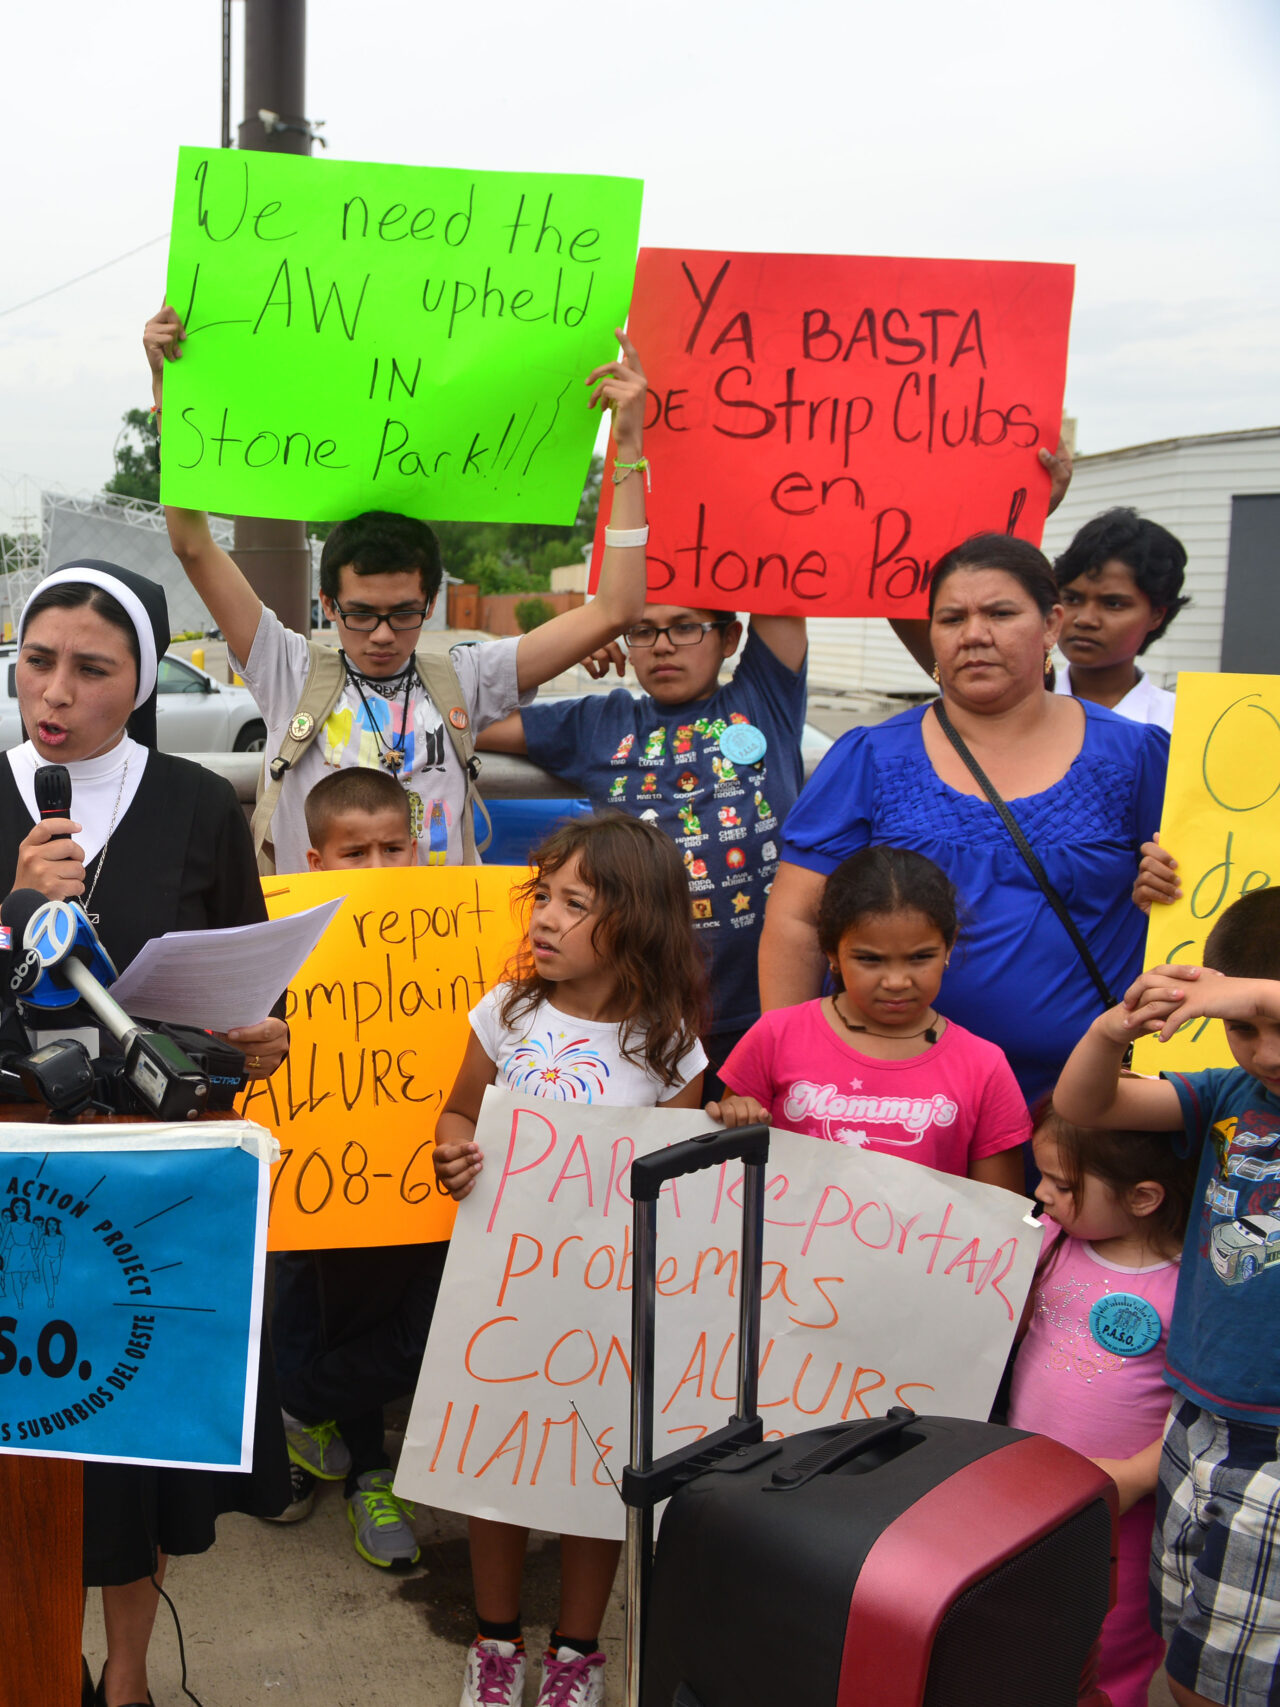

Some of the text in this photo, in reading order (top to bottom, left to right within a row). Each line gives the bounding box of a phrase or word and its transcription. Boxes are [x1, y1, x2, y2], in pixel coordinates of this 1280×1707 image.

[194, 160, 602, 263] We need the
[181, 258, 595, 341] LAW upheld
[801, 307, 988, 369] BASTA
[368, 357, 422, 402] IN
[178, 406, 351, 469] Stone
[712, 365, 874, 468] Strip
[893, 371, 1041, 454] Clubs
[770, 471, 866, 516] en
[675, 833, 709, 844] HAMMER
[684, 840, 702, 848] BRO
[352, 878, 495, 963] report
[11, 950, 38, 990] abc
[785, 1081, 957, 1132] Mommy's
[267, 1140, 455, 1229] 708-6
[5, 1176, 91, 1219] ACTION
[92, 1219, 152, 1297] PROJECT
[496, 1225, 845, 1330] probemas
[1102, 1324, 1134, 1347] P.A.S.O.
[17, 1388, 115, 1441] SUBURBIOS
[105, 1364, 127, 1391] DEL
[126, 1314, 155, 1366] OESTE
